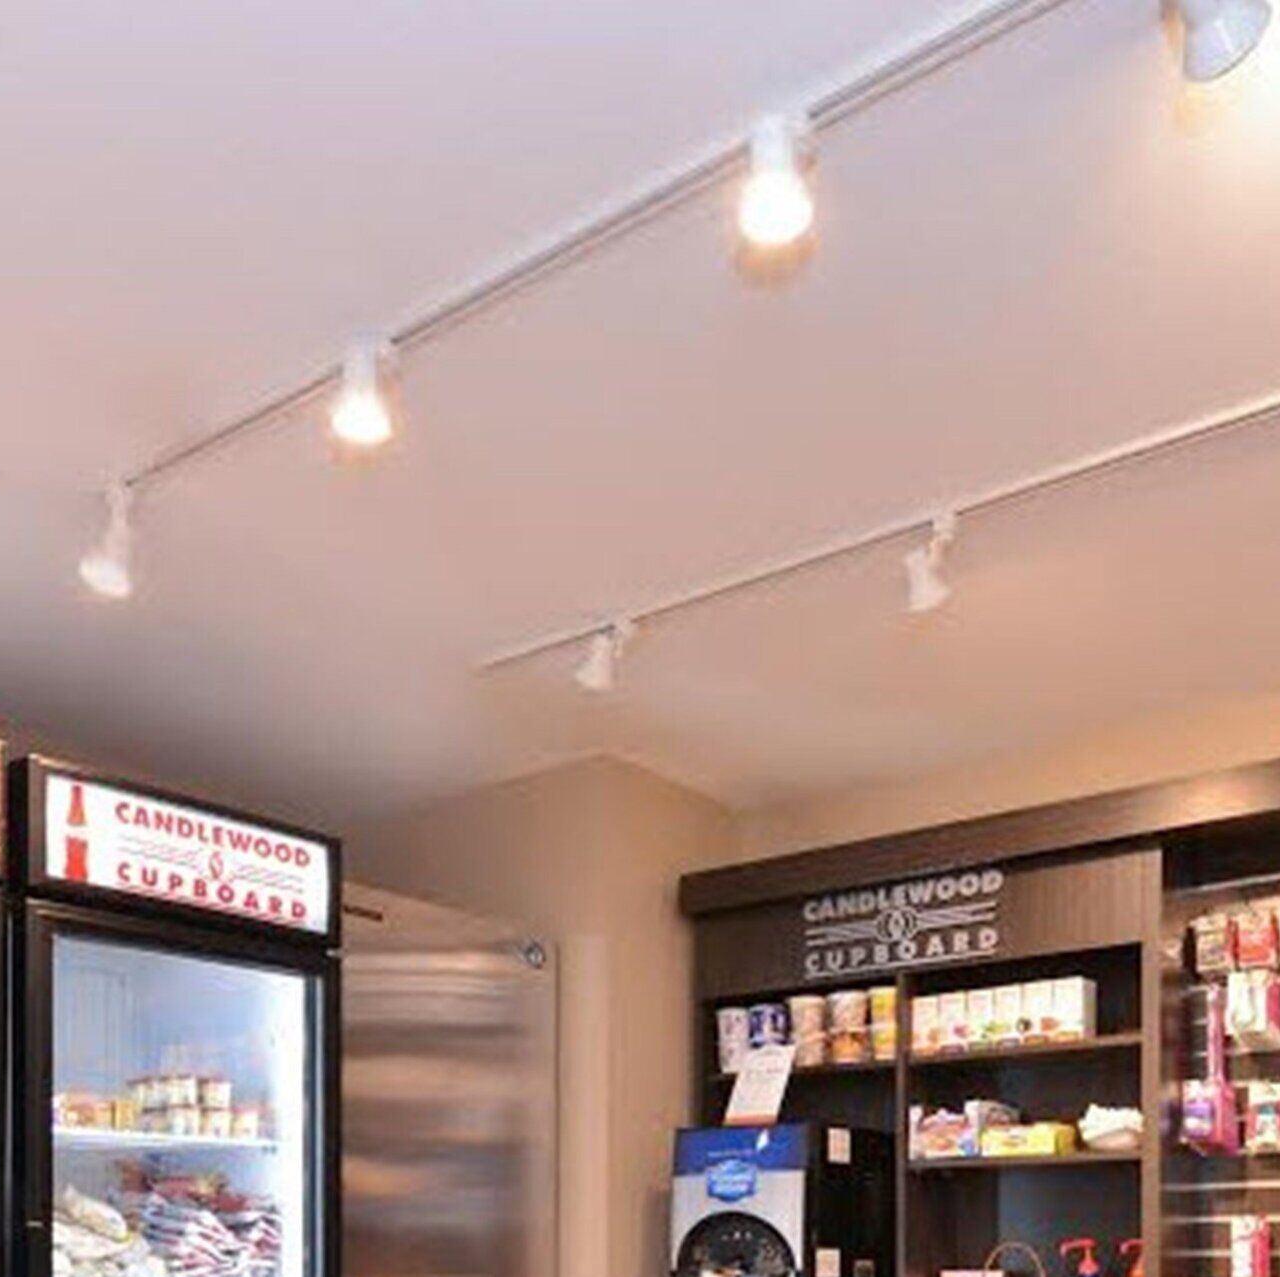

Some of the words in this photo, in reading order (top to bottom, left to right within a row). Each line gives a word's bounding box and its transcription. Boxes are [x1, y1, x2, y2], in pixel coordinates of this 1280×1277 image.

[114, 801, 312, 868] CANDLEWOOD
[116, 861, 308, 919] CUPBOARD
[804, 870, 1004, 921] CANDLEWOOD
[805, 928, 999, 972] CUPBOARD
